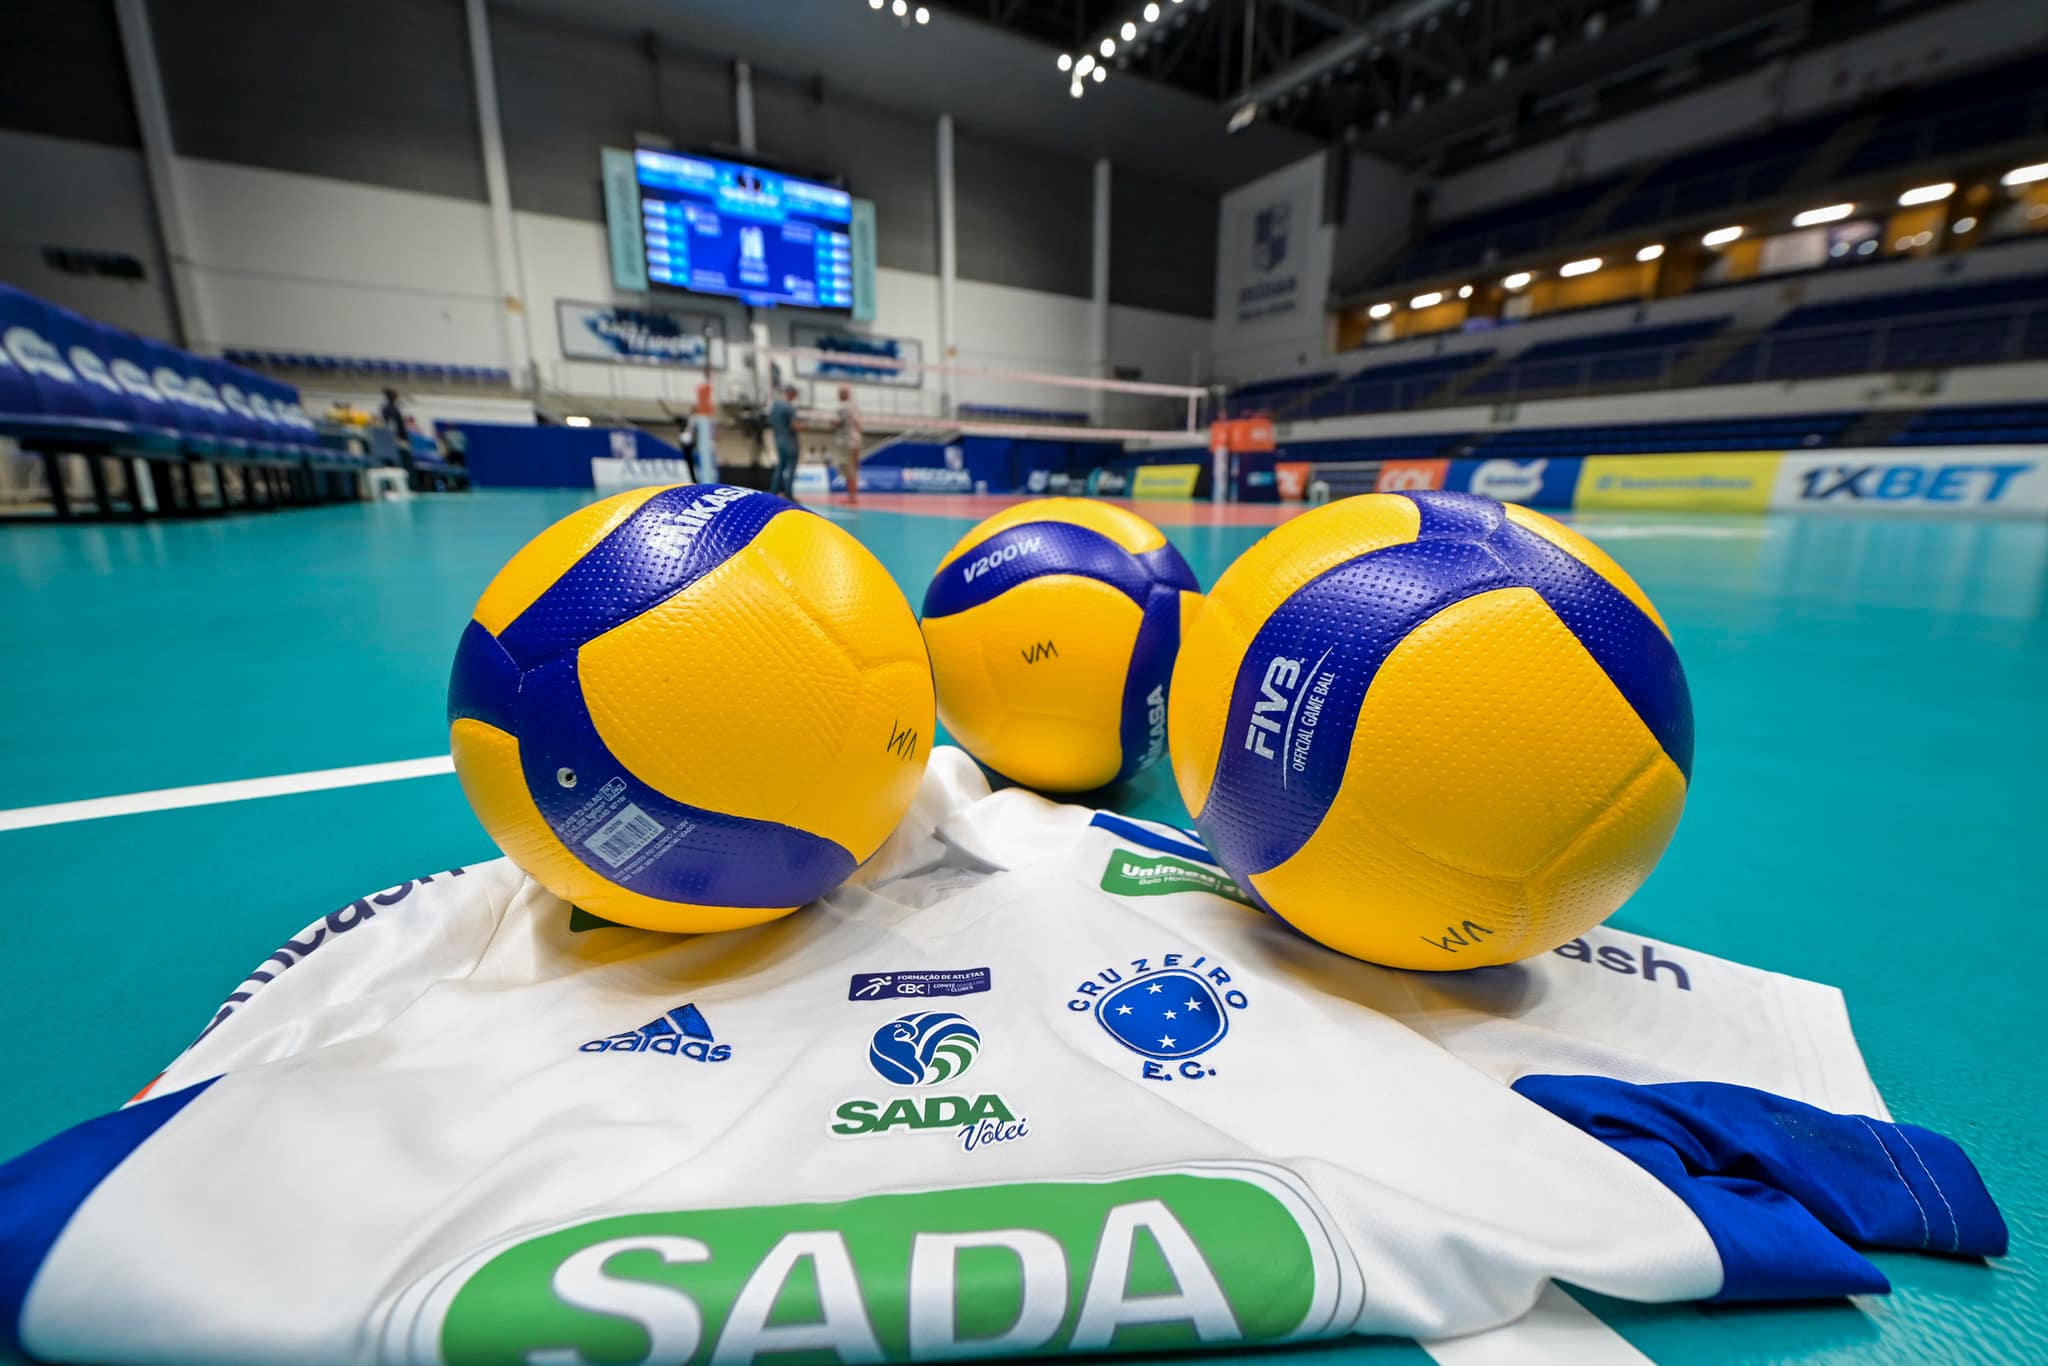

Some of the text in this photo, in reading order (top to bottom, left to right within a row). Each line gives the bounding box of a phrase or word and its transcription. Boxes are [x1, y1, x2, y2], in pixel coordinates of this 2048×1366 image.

[1800, 463, 2036, 502] 1XBET
[963, 536, 1041, 584] V200W
[1245, 656, 1301, 760] FIVB
[1292, 672, 1335, 772] OFFICIAL GAME BALL
[896, 983, 925, 994] CBC
[952, 971, 985, 980] ATLETAS
[1067, 953, 1249, 1013] CRUZEIRO
[578, 1033, 732, 1063] adidas
[831, 1094, 1017, 1136] SADA
[958, 1118, 1030, 1151] Vôlei
[522, 1199, 1244, 1366] SADA
